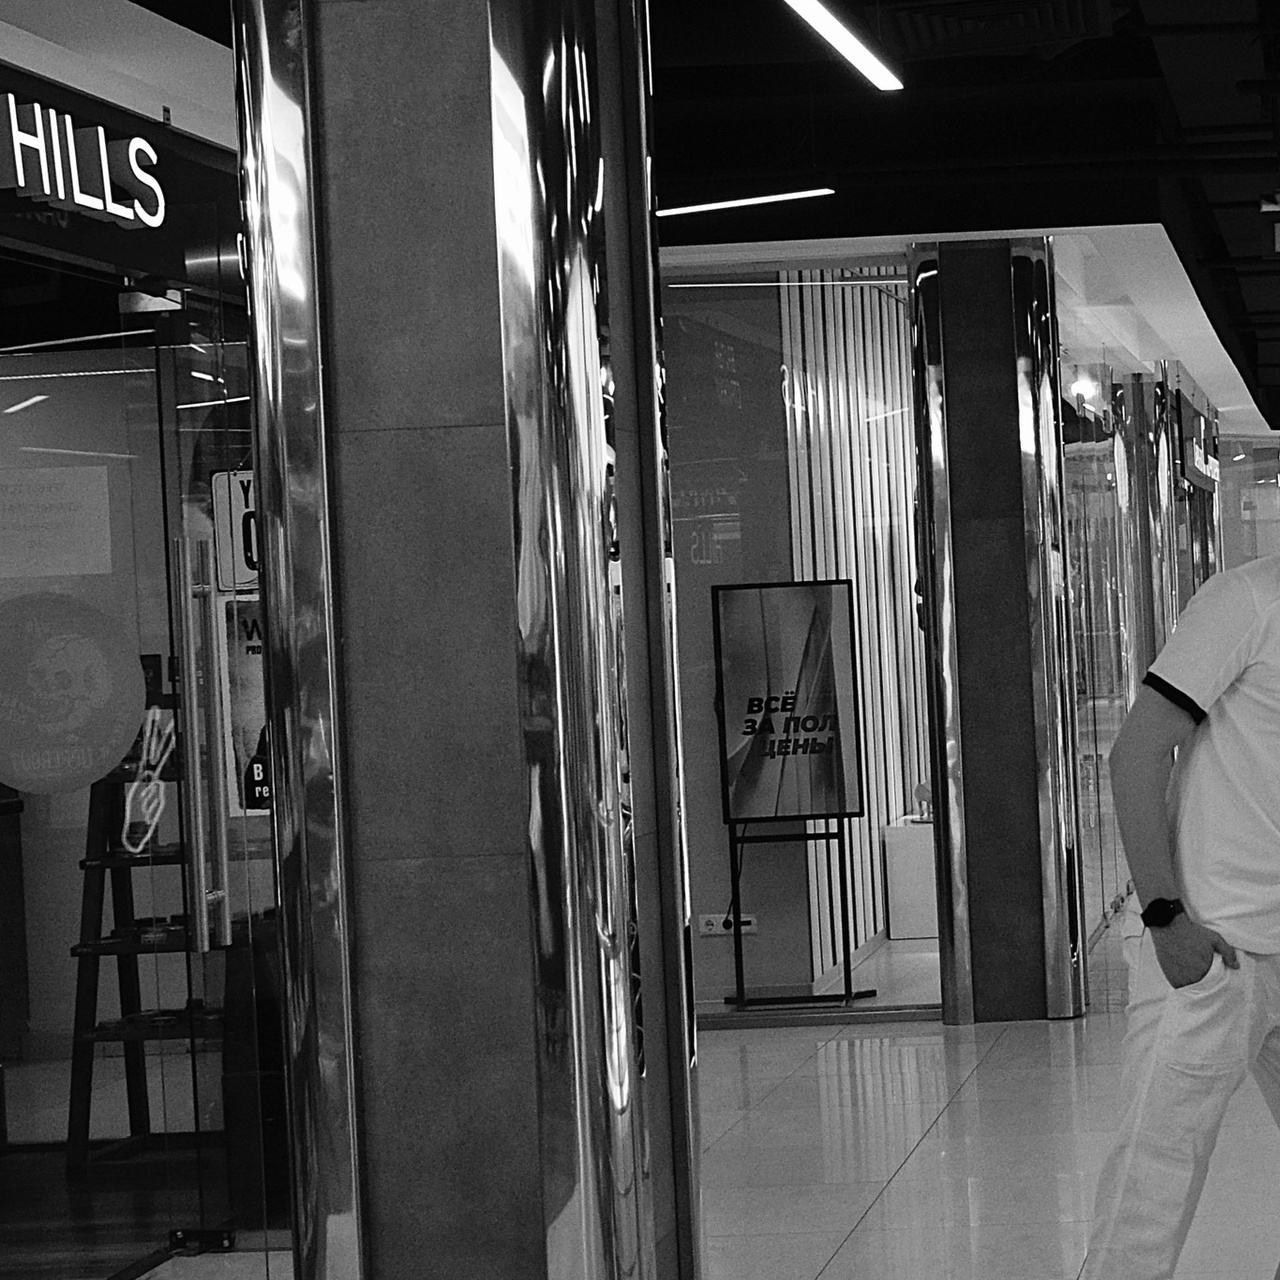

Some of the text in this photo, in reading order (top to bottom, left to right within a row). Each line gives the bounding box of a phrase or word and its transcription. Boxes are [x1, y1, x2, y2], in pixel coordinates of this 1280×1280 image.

[7, 92, 166, 228] HILLS
[747, 690, 796, 714] ВСЁ
[742, 715, 837, 735] ЗА ПОЛ
[764, 737, 834, 759] ЦЕНЫ
